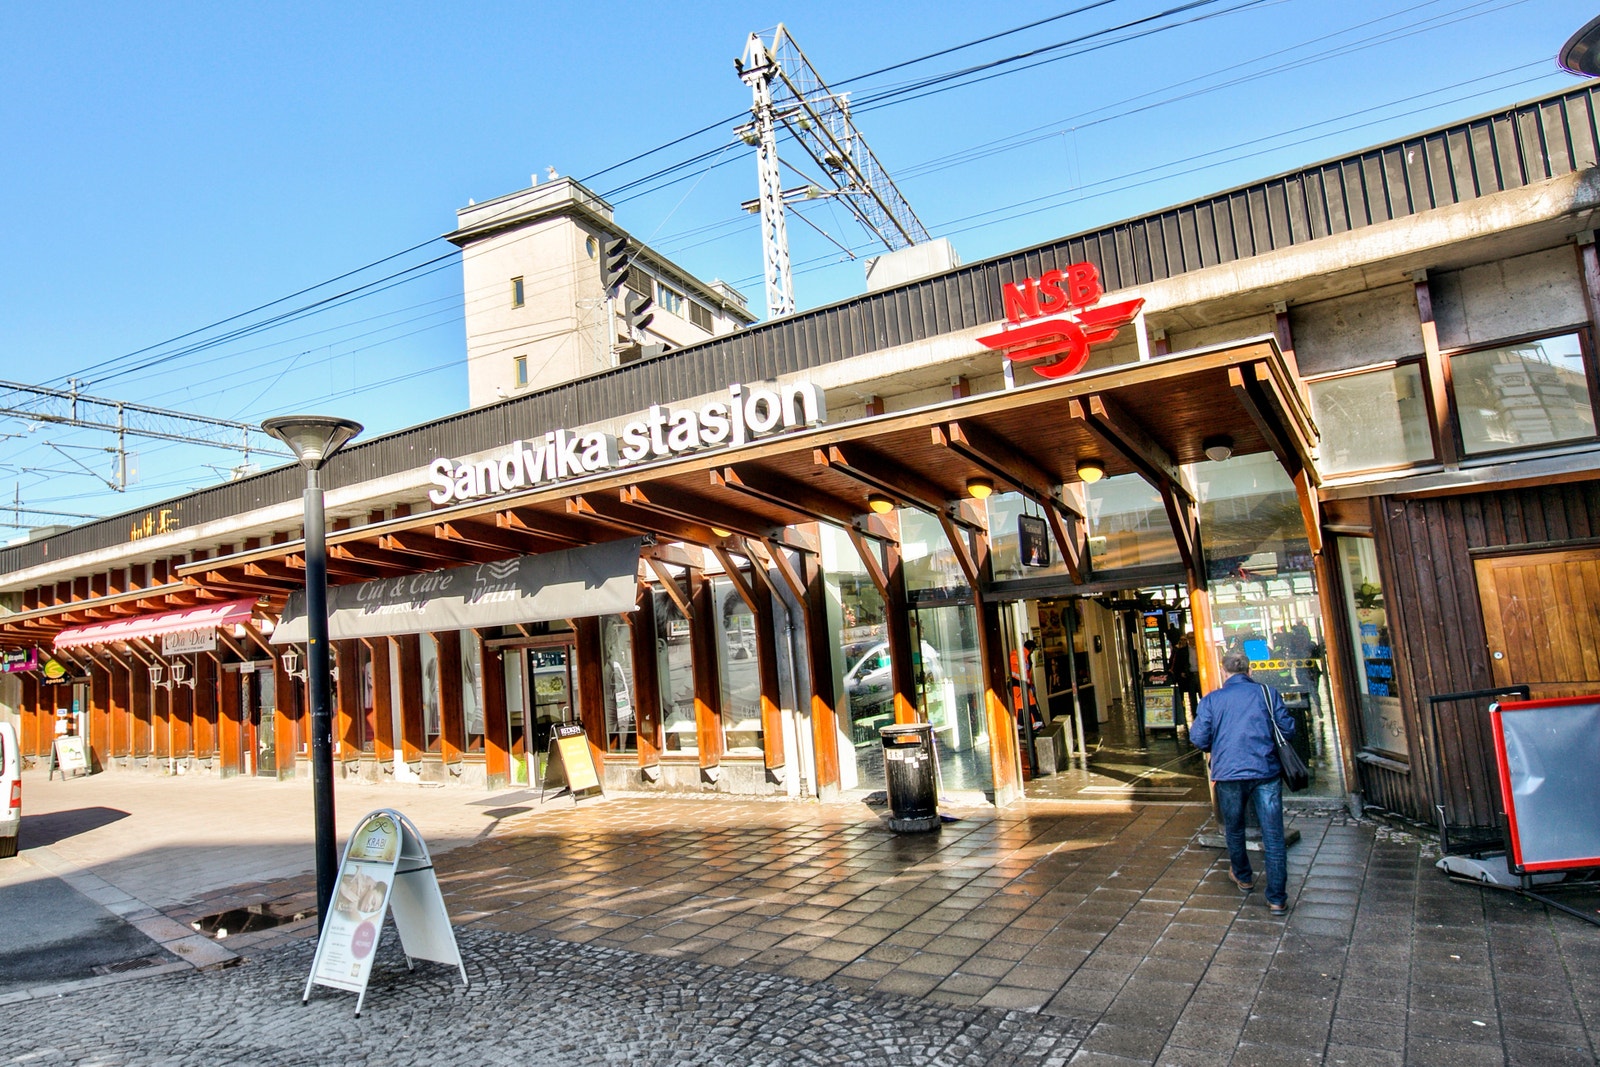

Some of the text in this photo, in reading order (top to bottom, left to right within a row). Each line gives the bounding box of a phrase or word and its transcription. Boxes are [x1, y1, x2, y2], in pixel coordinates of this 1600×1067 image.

[1003, 262, 1104, 323] NSB
[428, 381, 826, 505] Sandvika stasjon
[356, 572, 453, 602] Cut & Care
[470, 582, 517, 606] WELLA
[366, 837, 387, 848] KRABI
